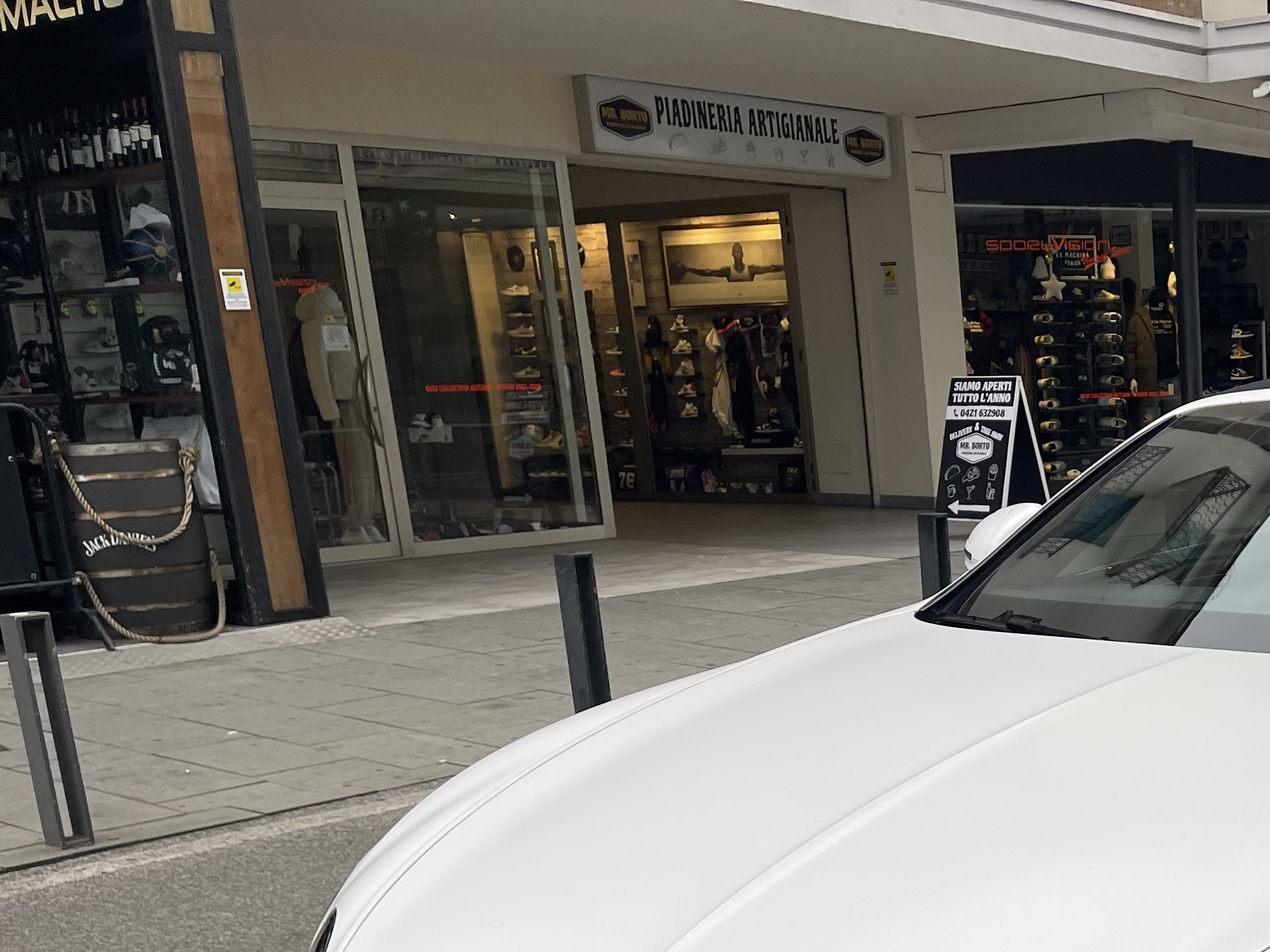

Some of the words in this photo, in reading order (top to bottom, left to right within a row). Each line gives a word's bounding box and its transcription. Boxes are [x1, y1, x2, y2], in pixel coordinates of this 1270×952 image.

[654, 95, 744, 135] PIADINERIA
[748, 108, 840, 144] ARTIGIANALE
[953, 381, 981, 391] SIAMO
[982, 381, 1012, 391] APERTI
[952, 393, 979, 403] TUTTO
[980, 393, 1011, 403] L'ANNO
[960, 409, 977, 417] 0421
[979, 409, 1005, 417] 632908
[974, 422, 980, 431] &
[82, 535, 111, 557] JACK
